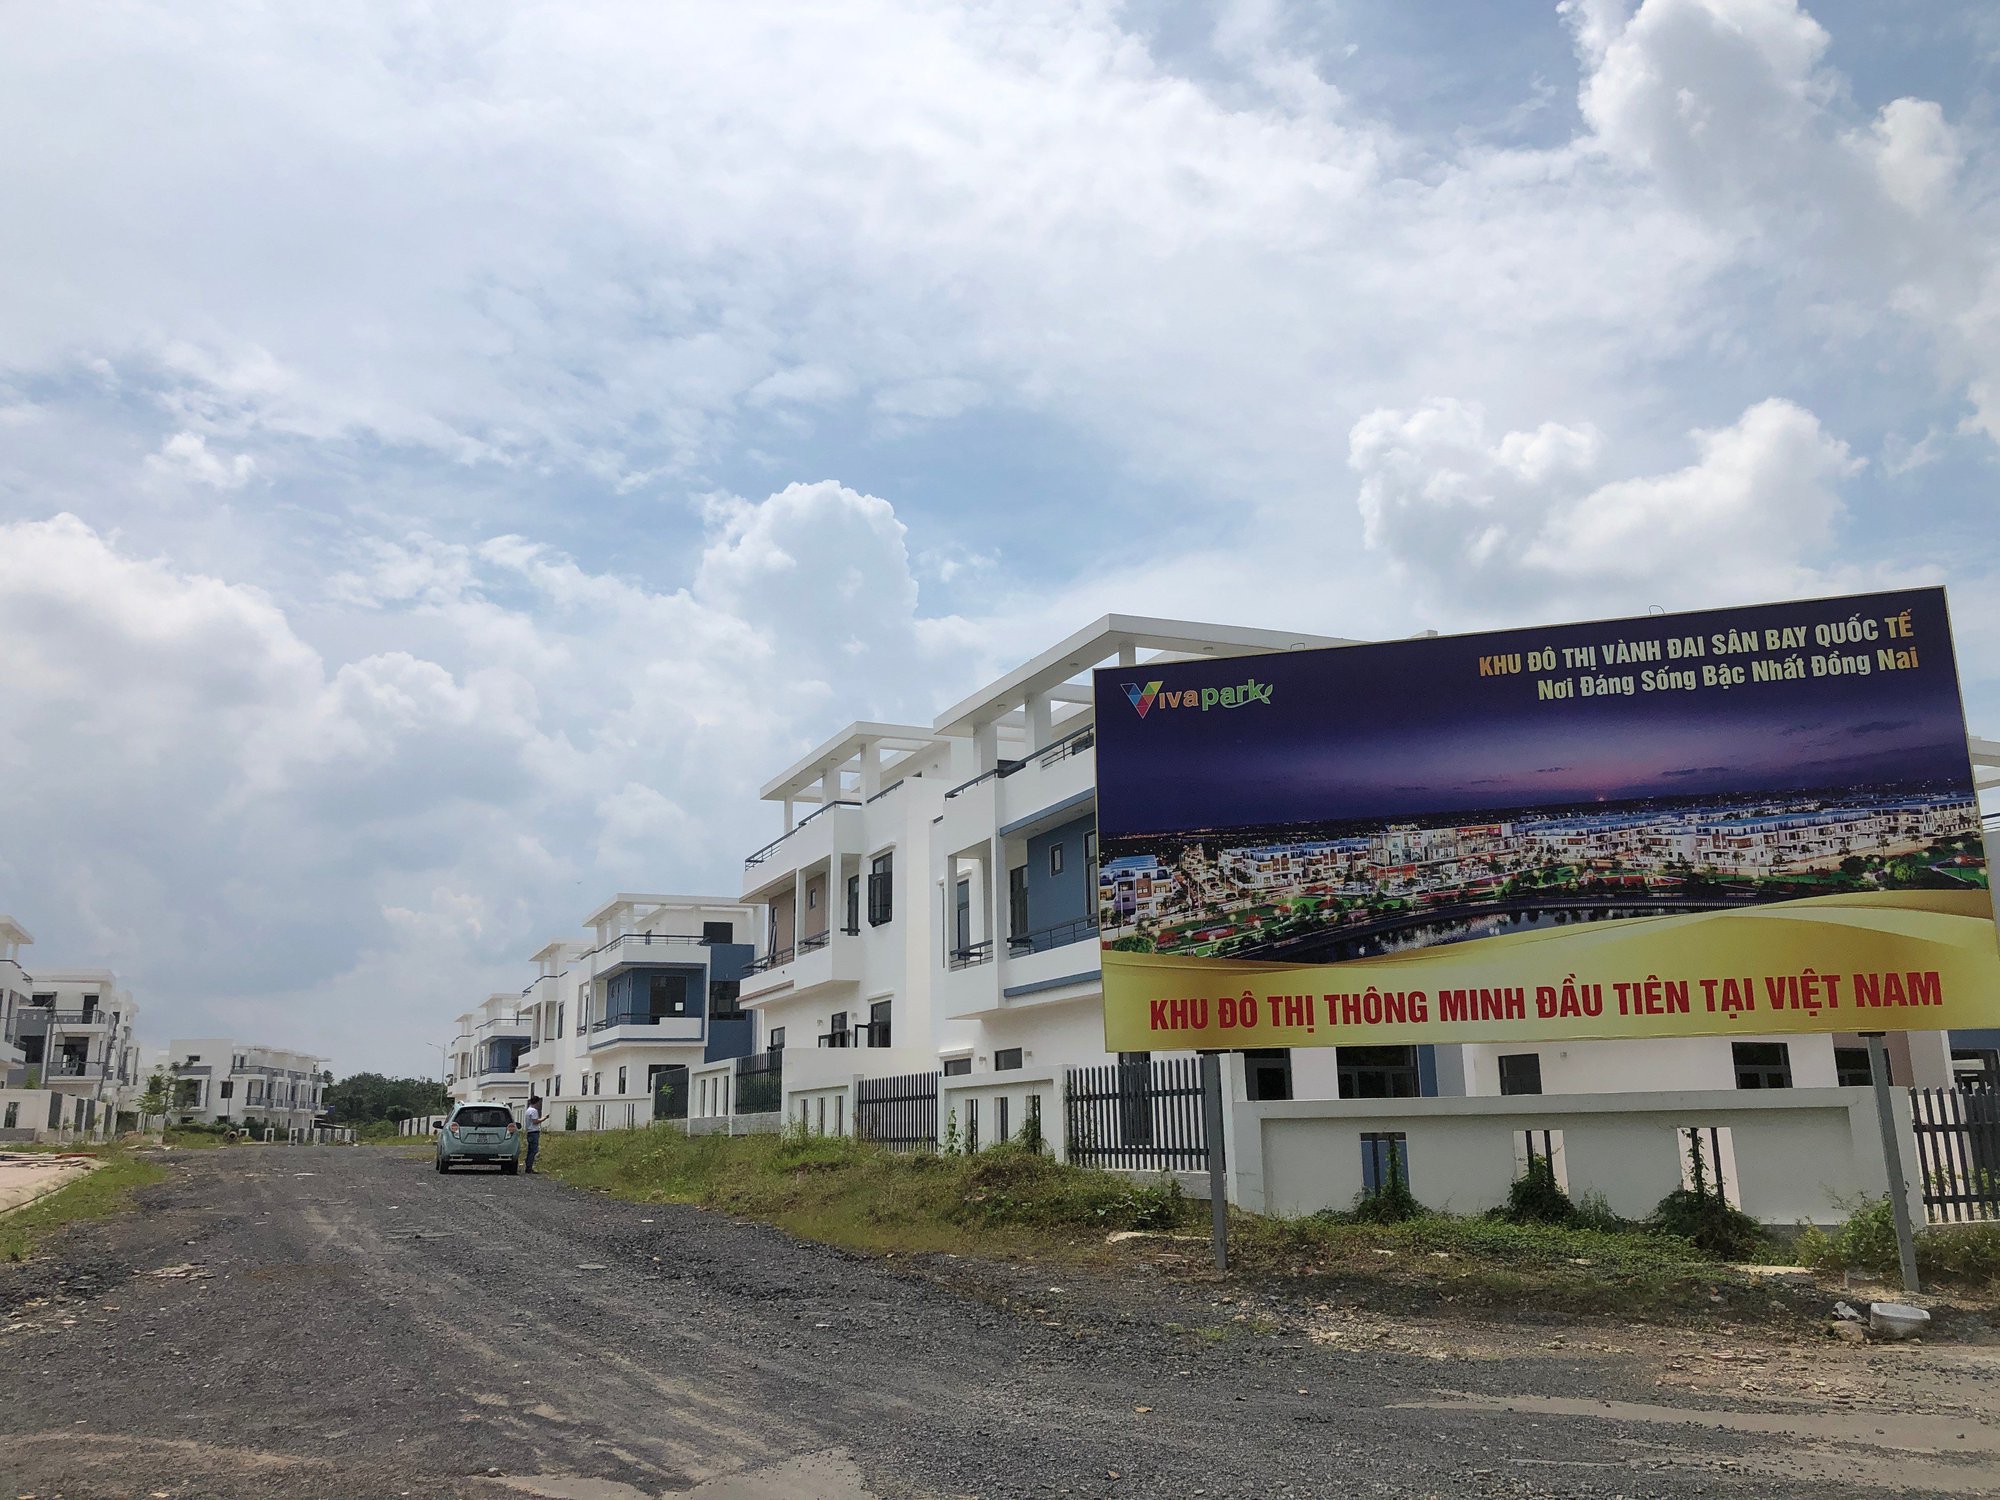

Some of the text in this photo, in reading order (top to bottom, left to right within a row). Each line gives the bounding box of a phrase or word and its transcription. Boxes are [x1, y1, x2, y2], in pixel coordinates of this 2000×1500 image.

[1479, 608, 1914, 677] KHU ĐÔ THỊ VÀNH ĐAI SÂN BAY QUỐC TẾ
[1120, 678, 1274, 719] Vivapark
[1538, 646, 1919, 700] Nơi Đáng Sống Bậc Nhất Đồng Nai
[1150, 967, 1944, 1034] KHU ĐÔ THỊ THÔNG MINH ĐẦU TIÊN TẠI VIỆT NAM
